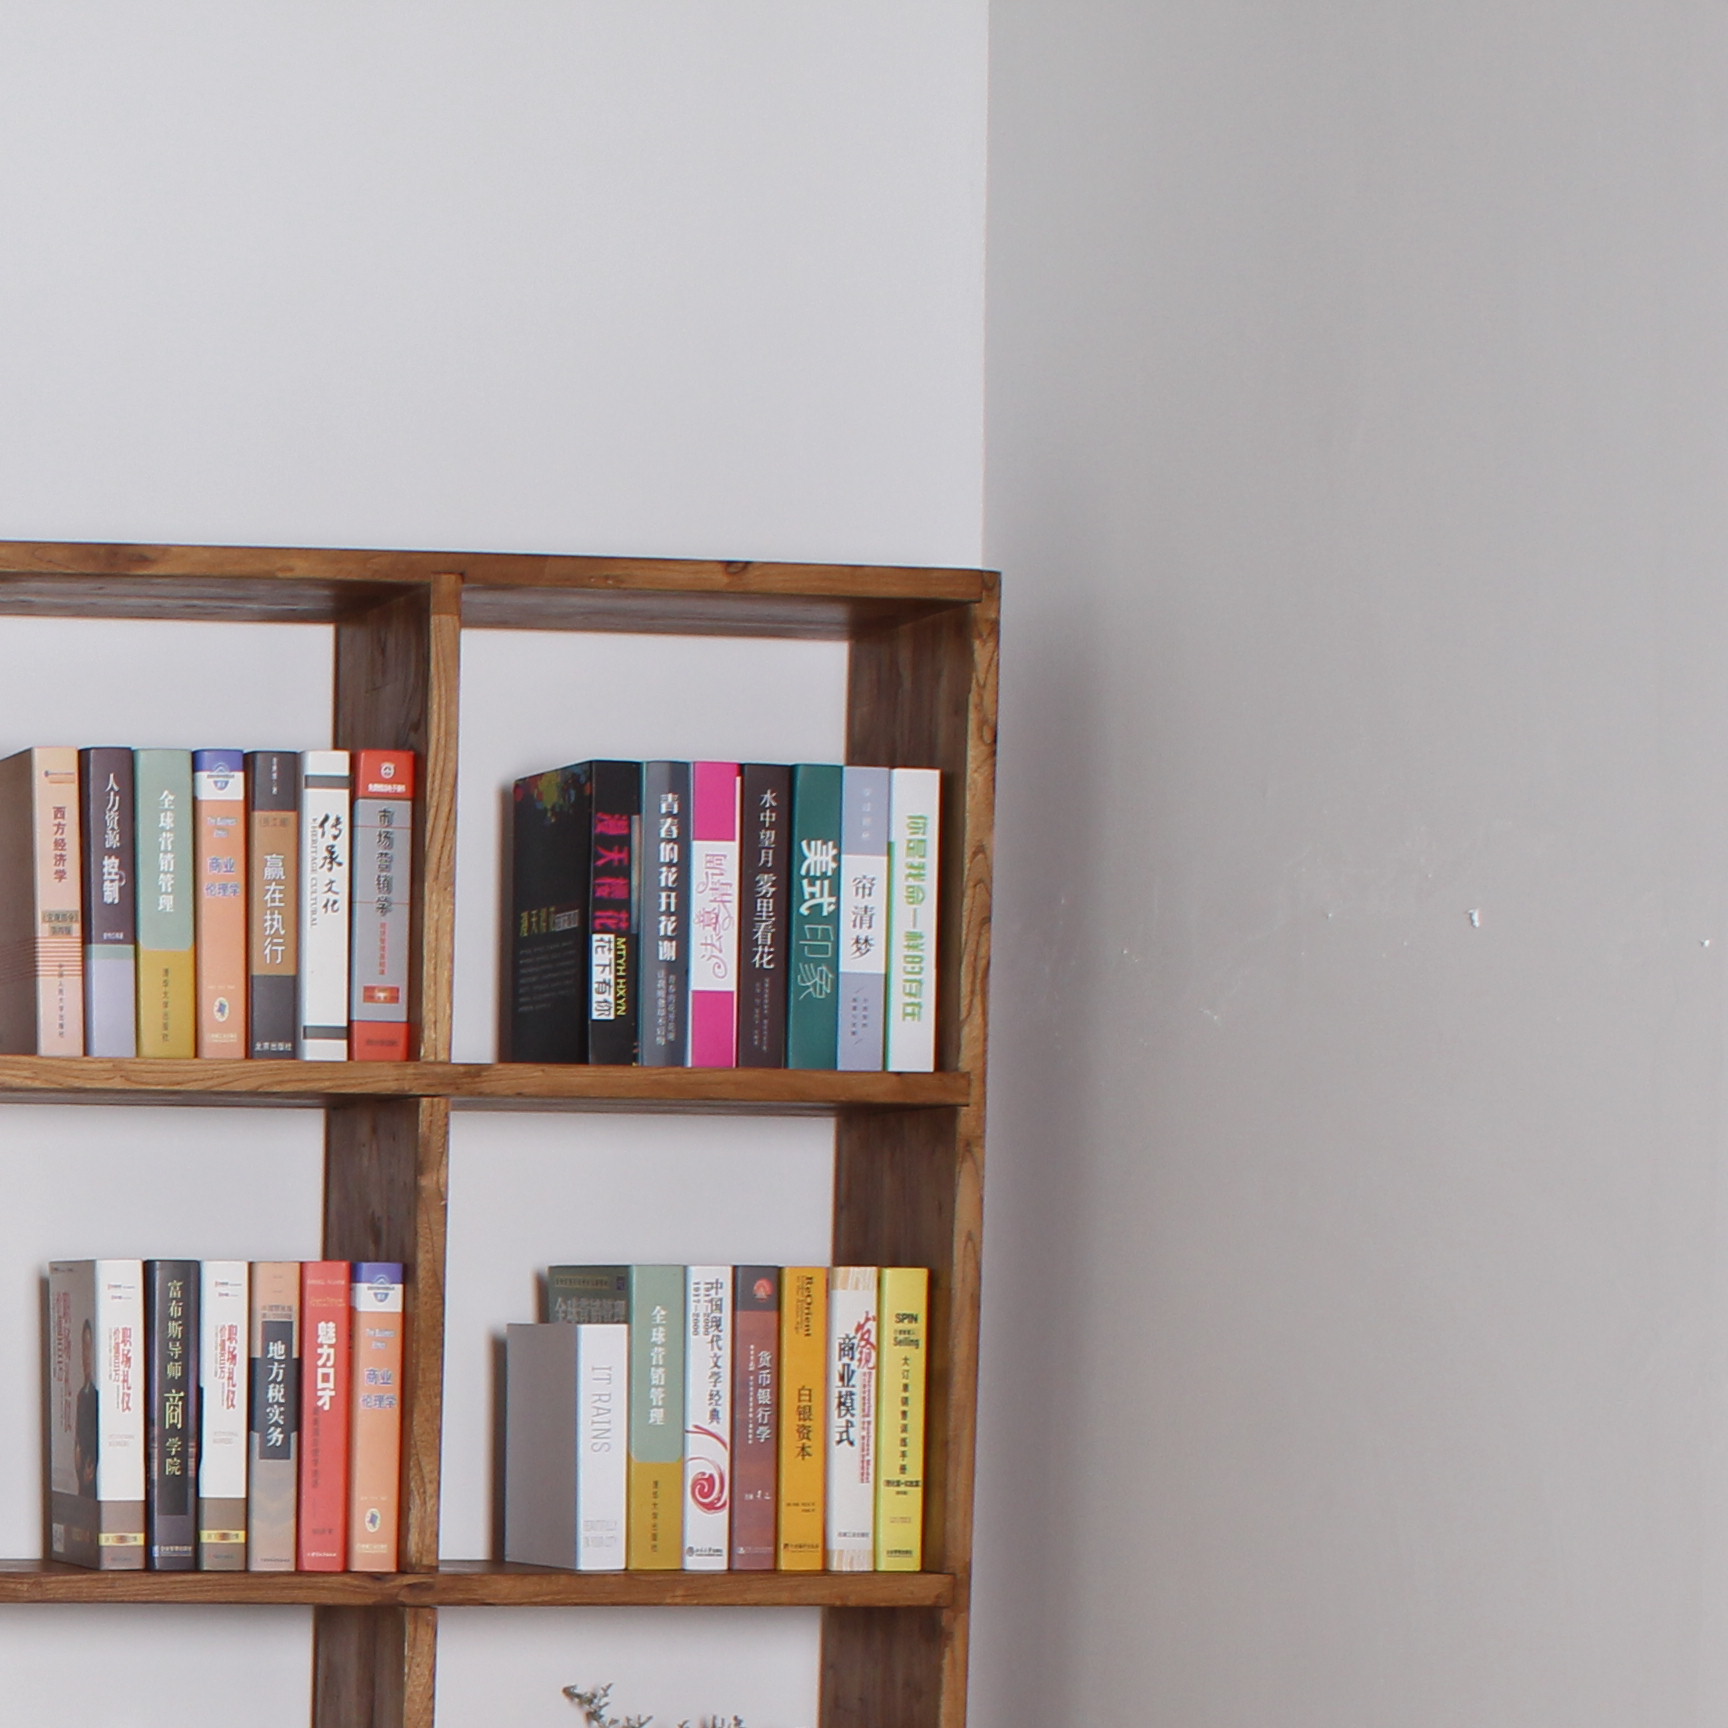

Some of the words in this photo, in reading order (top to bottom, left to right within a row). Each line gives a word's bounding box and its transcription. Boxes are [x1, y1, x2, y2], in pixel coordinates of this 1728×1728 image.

[52, 805, 69, 883] 西方经济学
[104, 772, 121, 849] 人力资源
[157, 789, 176, 913] 全球营销管理
[757, 788, 777, 868] 水中望月
[205, 881, 240, 898] 伦理学
[208, 856, 236, 874] 商业
[319, 811, 344, 915] 传承文化
[375, 807, 394, 917] 市场营销学
[593, 811, 630, 931] 漫天樱花
[657, 792, 680, 963] 青春的花开花谢
[263, 854, 286, 966] 赢在执行
[616, 936, 627, 976] MTYH
[751, 873, 778, 970] 雾里看花
[798, 838, 840, 1001] 美式印象
[901, 814, 929, 1023] 你是我命一样的存在
[594, 936, 613, 1017] 花下有你
[616, 978, 627, 1016] HXYN
[165, 1280, 185, 1381] 富布斯导师
[708, 1277, 724, 1425] 中国现代文学经典
[893, 1312, 919, 1325] SPIN
[266, 1339, 287, 1448] 地方税实务
[316, 1319, 337, 1411] 魅力口才
[361, 1393, 397, 1410] 伦理学
[364, 1367, 393, 1385] 商业
[590, 1366, 613, 1385] IT
[647, 1304, 668, 1427] 全球营销管理
[754, 1350, 773, 1443] 货币银行学
[834, 1333, 857, 1448] 商业模式
[163, 1388, 185, 1476] 商学院
[590, 1393, 613, 1453] RAINS
[795, 1385, 813, 1461] 白银资本
